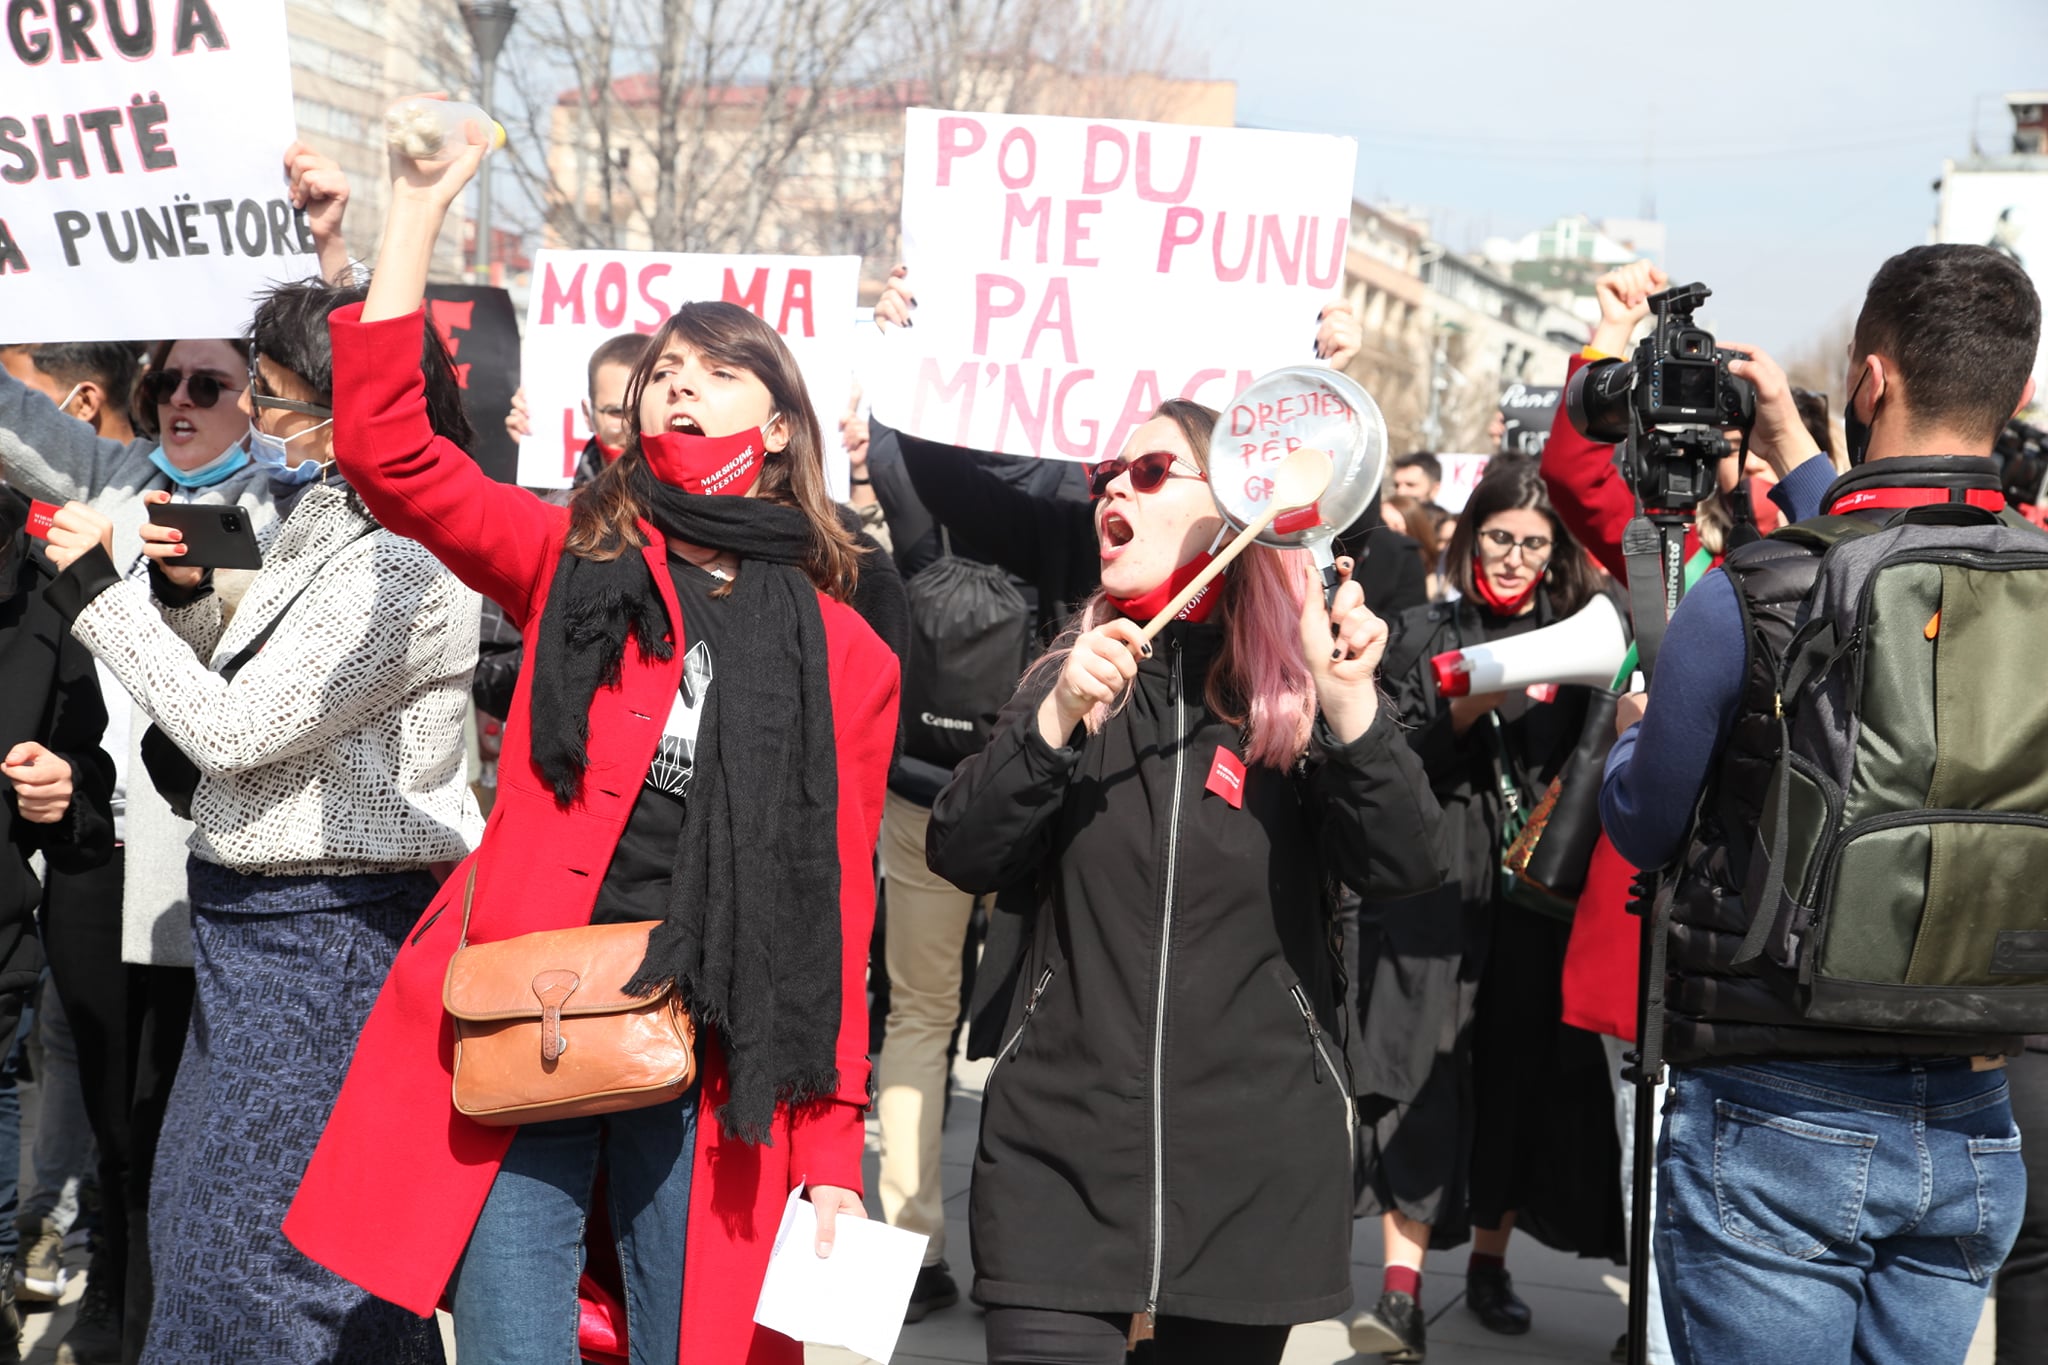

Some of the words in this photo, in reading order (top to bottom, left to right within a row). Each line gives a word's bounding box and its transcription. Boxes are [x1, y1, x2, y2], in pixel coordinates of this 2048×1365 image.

[935, 116, 1037, 190] PO
[1081, 124, 1202, 204] DU
[1000, 192, 1103, 268] ME
[1155, 205, 1349, 290] PUNU
[539, 261, 672, 336] MOS
[720, 267, 815, 338] MA
[972, 272, 1079, 364] PA
[921, 712, 973, 731] Canon
